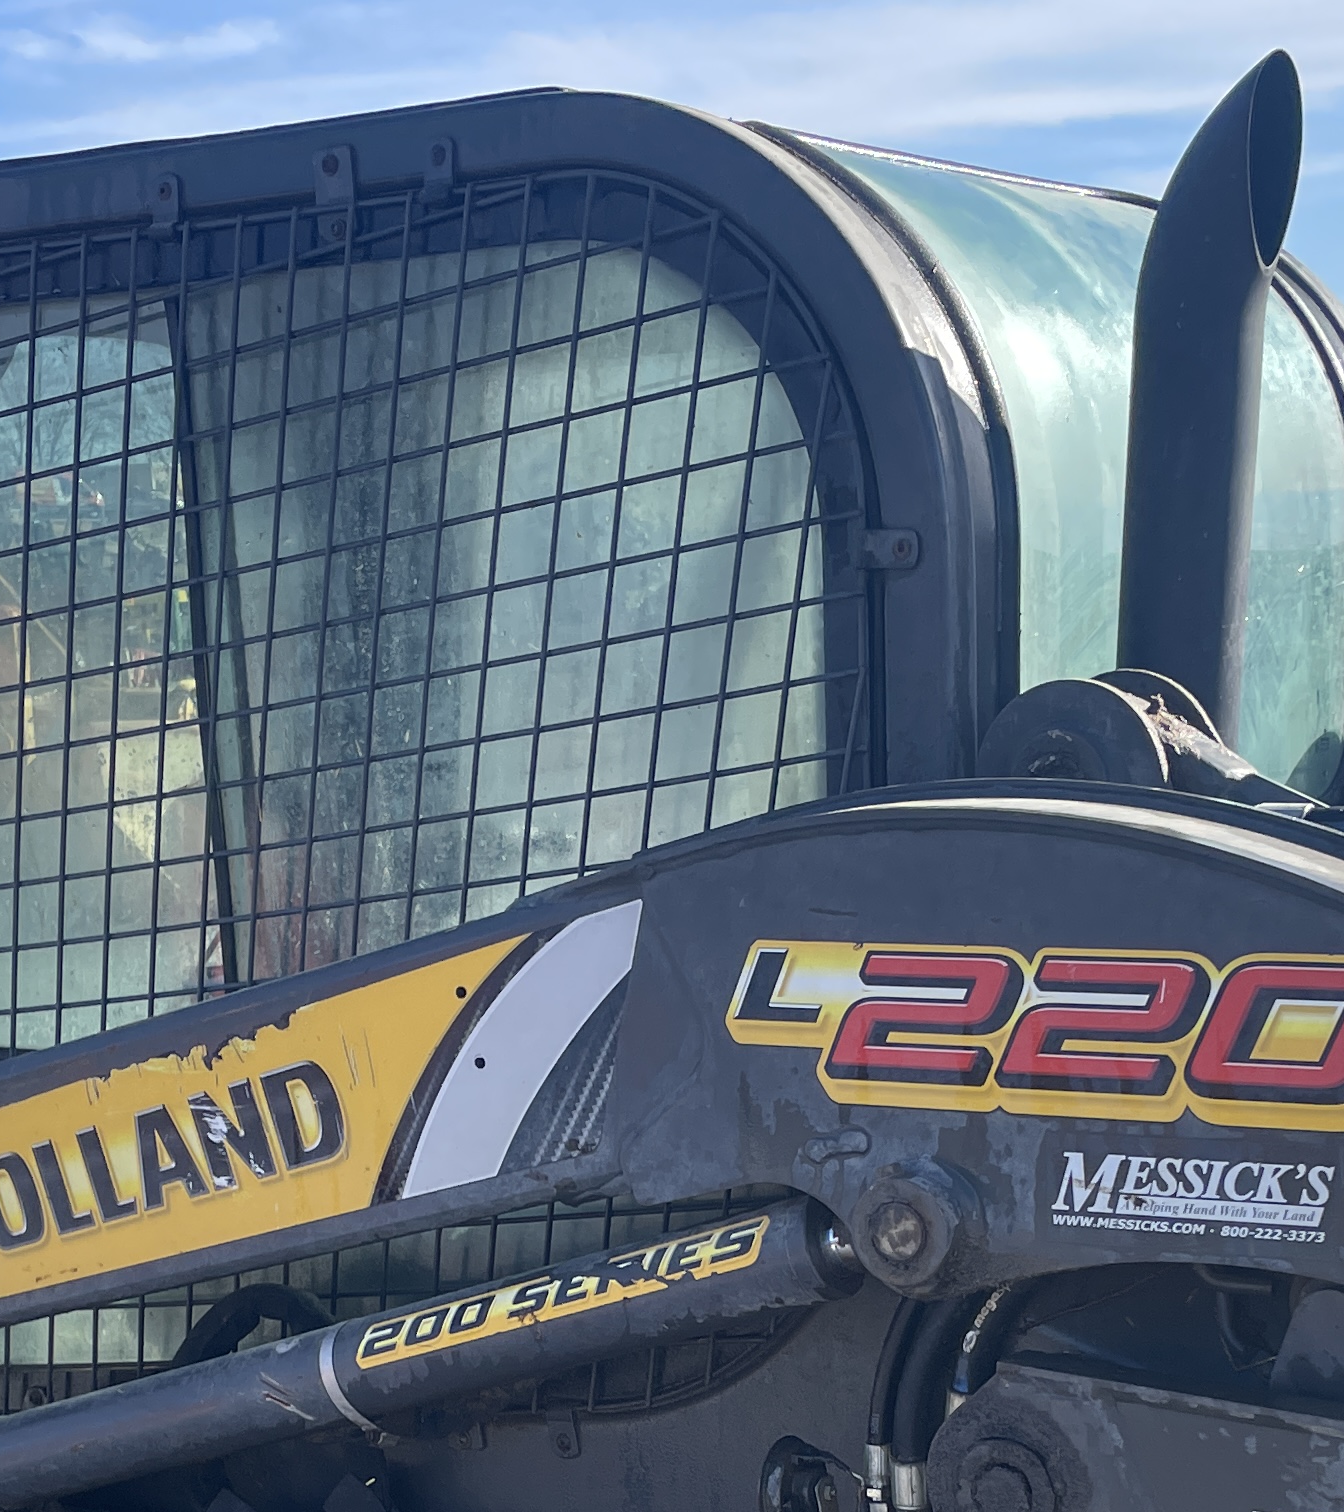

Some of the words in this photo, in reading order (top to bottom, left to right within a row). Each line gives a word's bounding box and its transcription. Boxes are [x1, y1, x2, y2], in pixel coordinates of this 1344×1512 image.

[1051, 1151, 1336, 1214] MESSICK'S
[1052, 1213, 1206, 1236] WWW.MESSICKS.COM
[1220, 1225, 1327, 1243] 800-222-3373
[1182, 1203, 1216, 1217] Hand
[1220, 1204, 1247, 1219] With
[1252, 1207, 1280, 1221] Your
[1282, 1209, 1316, 1223] Land
[361, 1295, 497, 1360] 200
